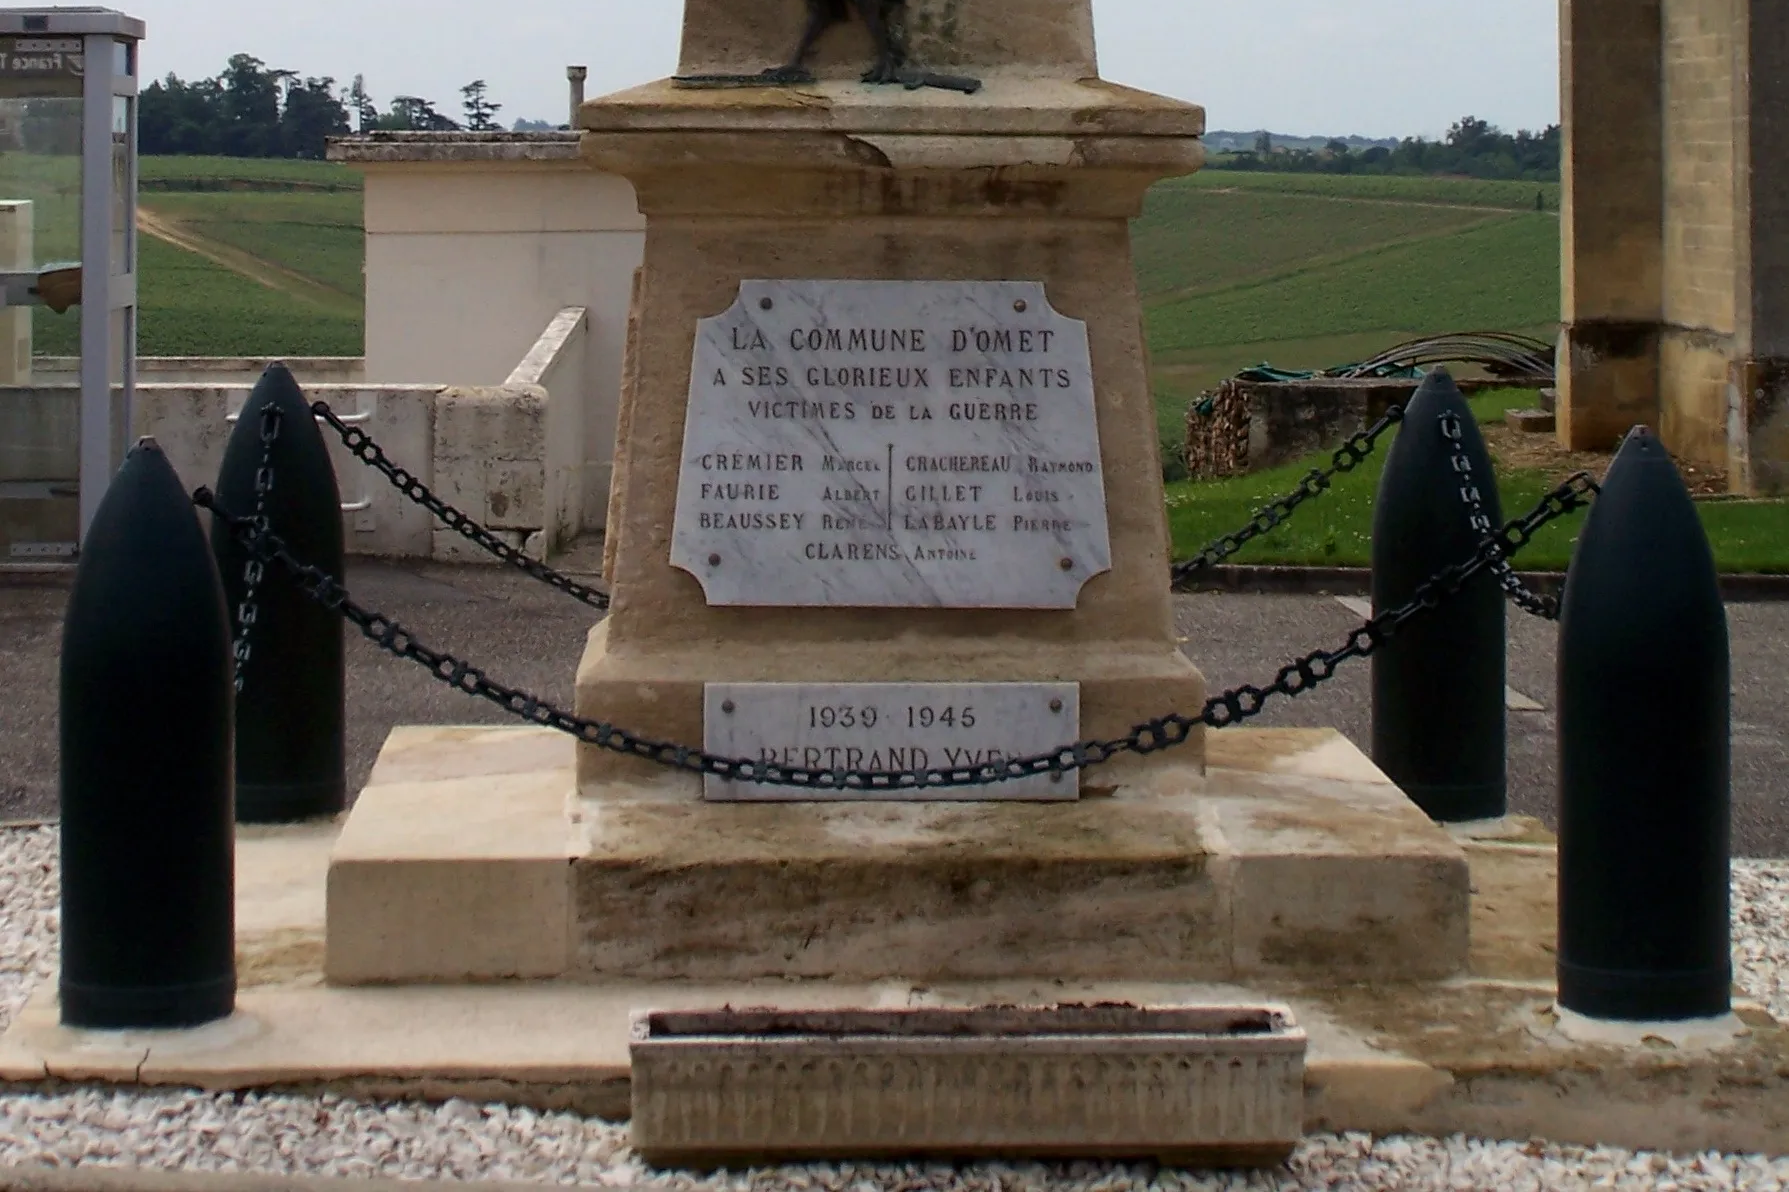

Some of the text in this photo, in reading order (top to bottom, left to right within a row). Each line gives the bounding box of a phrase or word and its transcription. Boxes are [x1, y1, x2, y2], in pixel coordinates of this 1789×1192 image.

[732, 326, 1054, 353] LA COMMUNE D'OMET
[713, 366, 1071, 388] A SES GLORIEUX ENFANTS
[748, 400, 1039, 421] VICTIMES DE LA GUERRE
[905, 455, 1094, 473] CRACHEREAU RAYMOND
[701, 484, 881, 501] FAURIE ALBERT
[905, 485, 983, 502] GILLET
[700, 512, 804, 530] BEAUSSEY
[904, 514, 1072, 532] LABAYLE PIERRE
[805, 542, 901, 560] CLARENS
[809, 706, 976, 729] 1939 1945
[760, 746, 1021, 772] BERTRAND YVE
